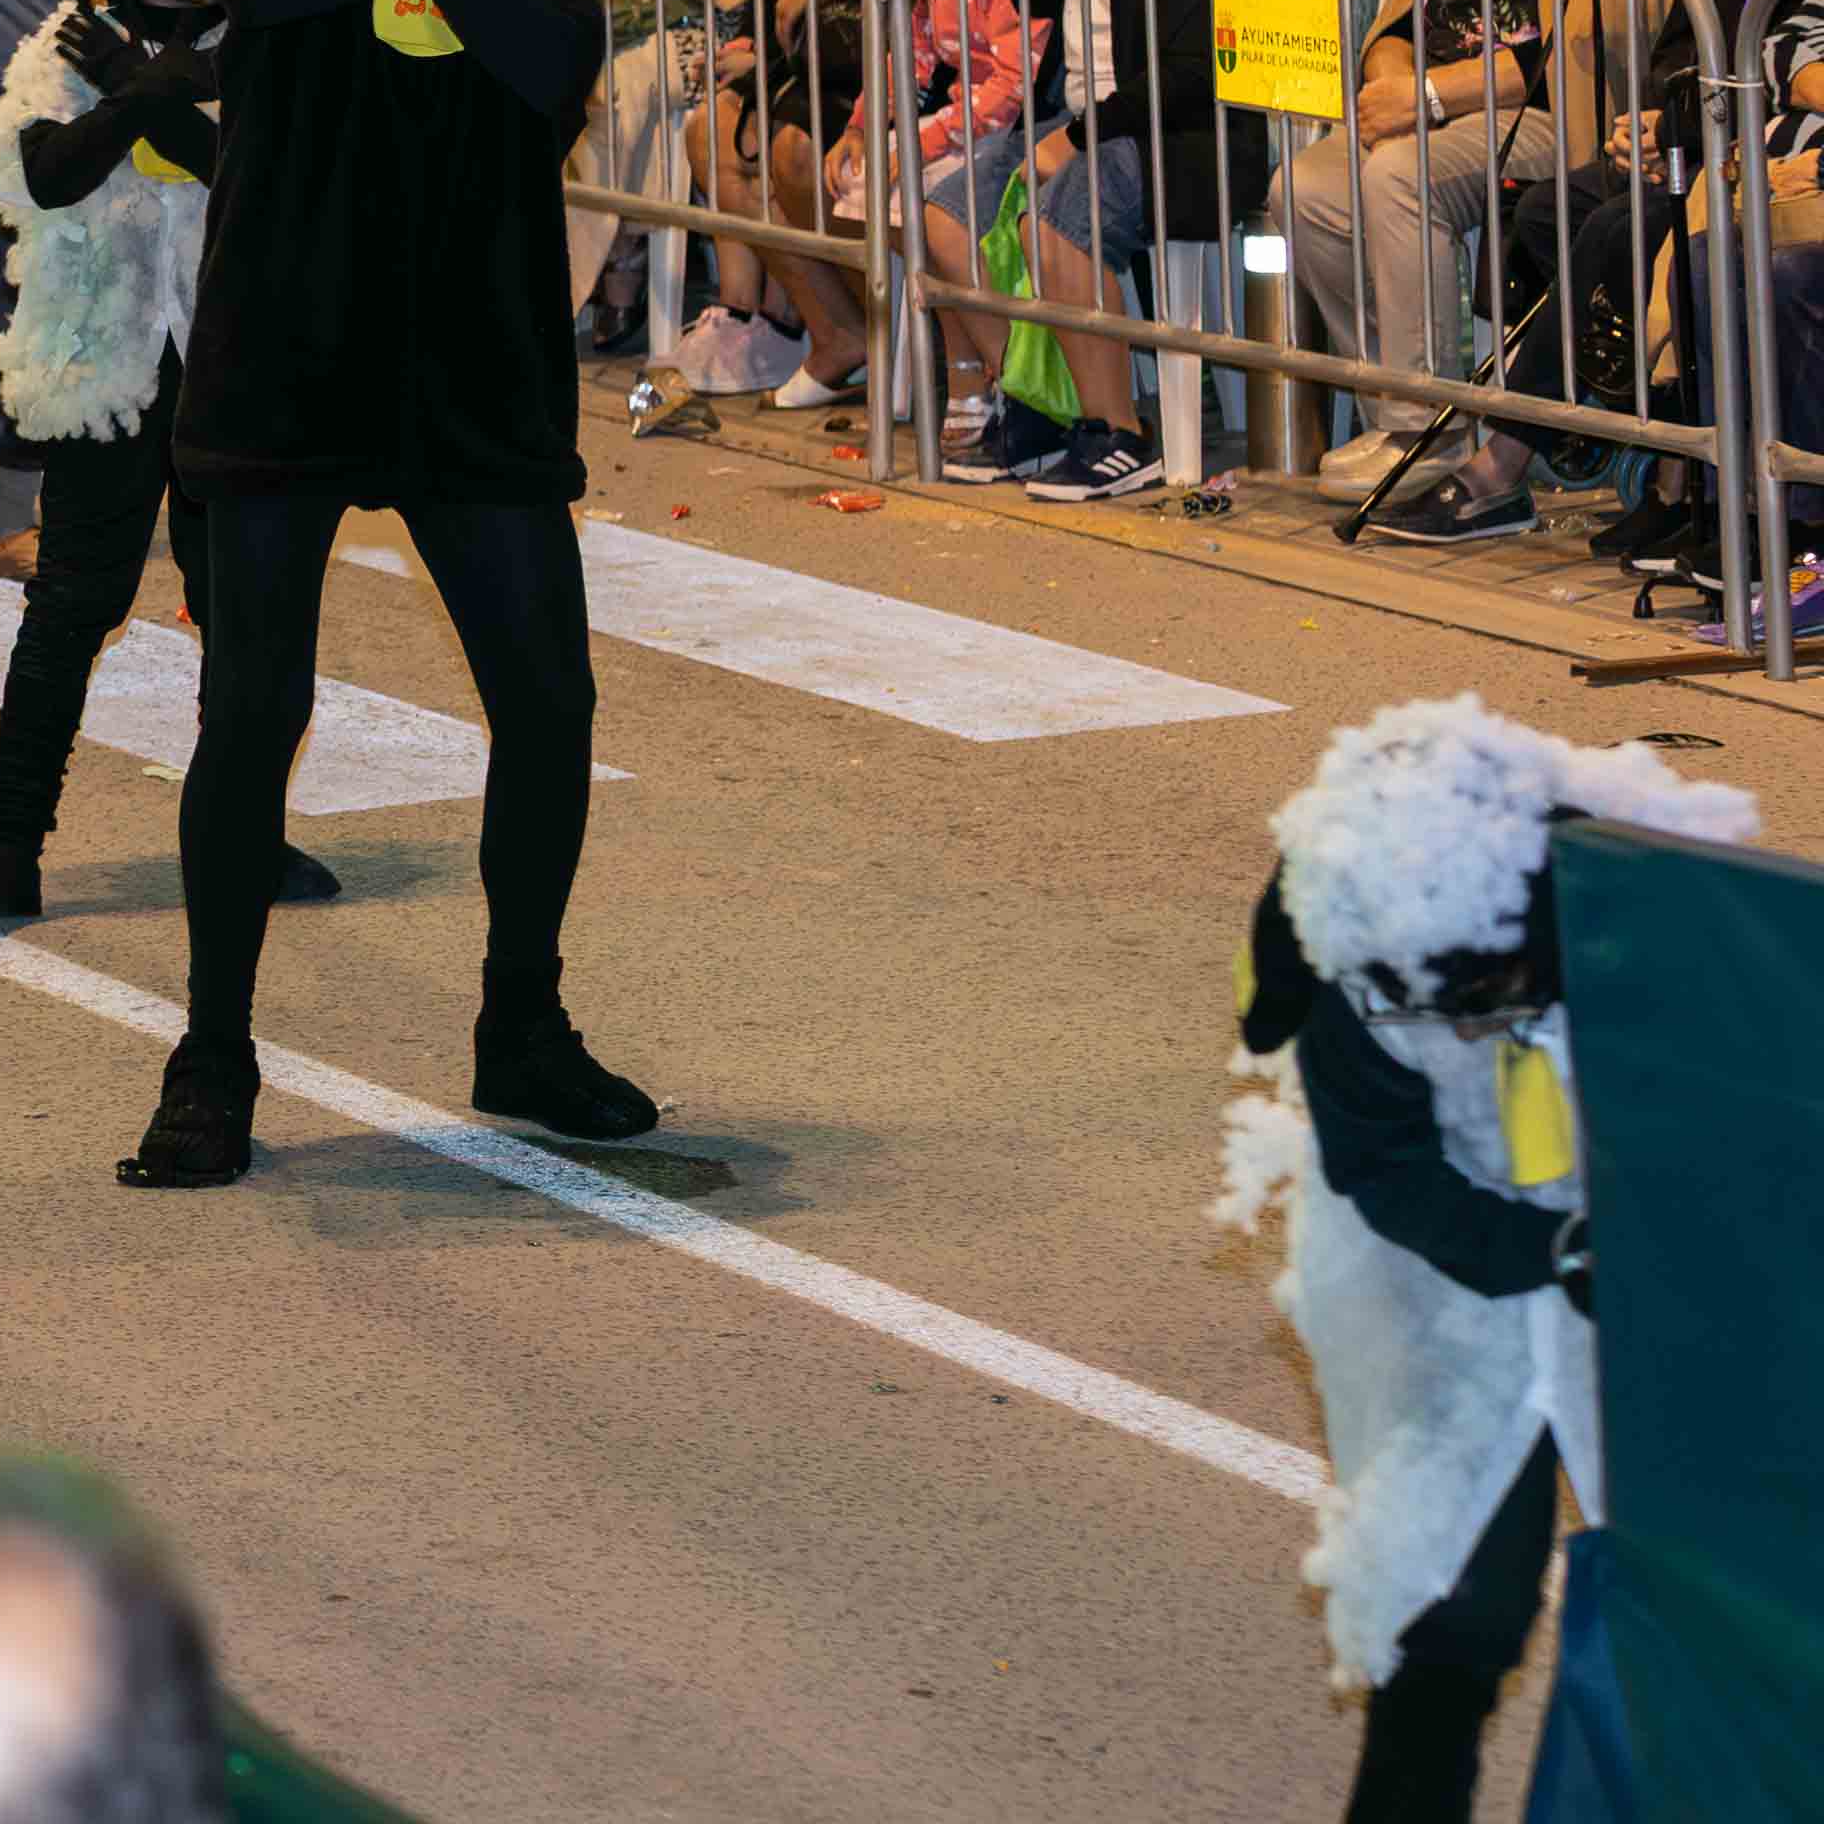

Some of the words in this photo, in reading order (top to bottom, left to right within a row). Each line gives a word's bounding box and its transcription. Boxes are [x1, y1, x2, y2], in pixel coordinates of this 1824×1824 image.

[1241, 26, 1338, 56] AYUNTAMIENTO
[1240, 49, 1264, 64] PILAR
[1267, 52, 1276, 65] DE
[1279, 55, 1289, 67] LA
[1292, 56, 1338, 75] HORADADA
